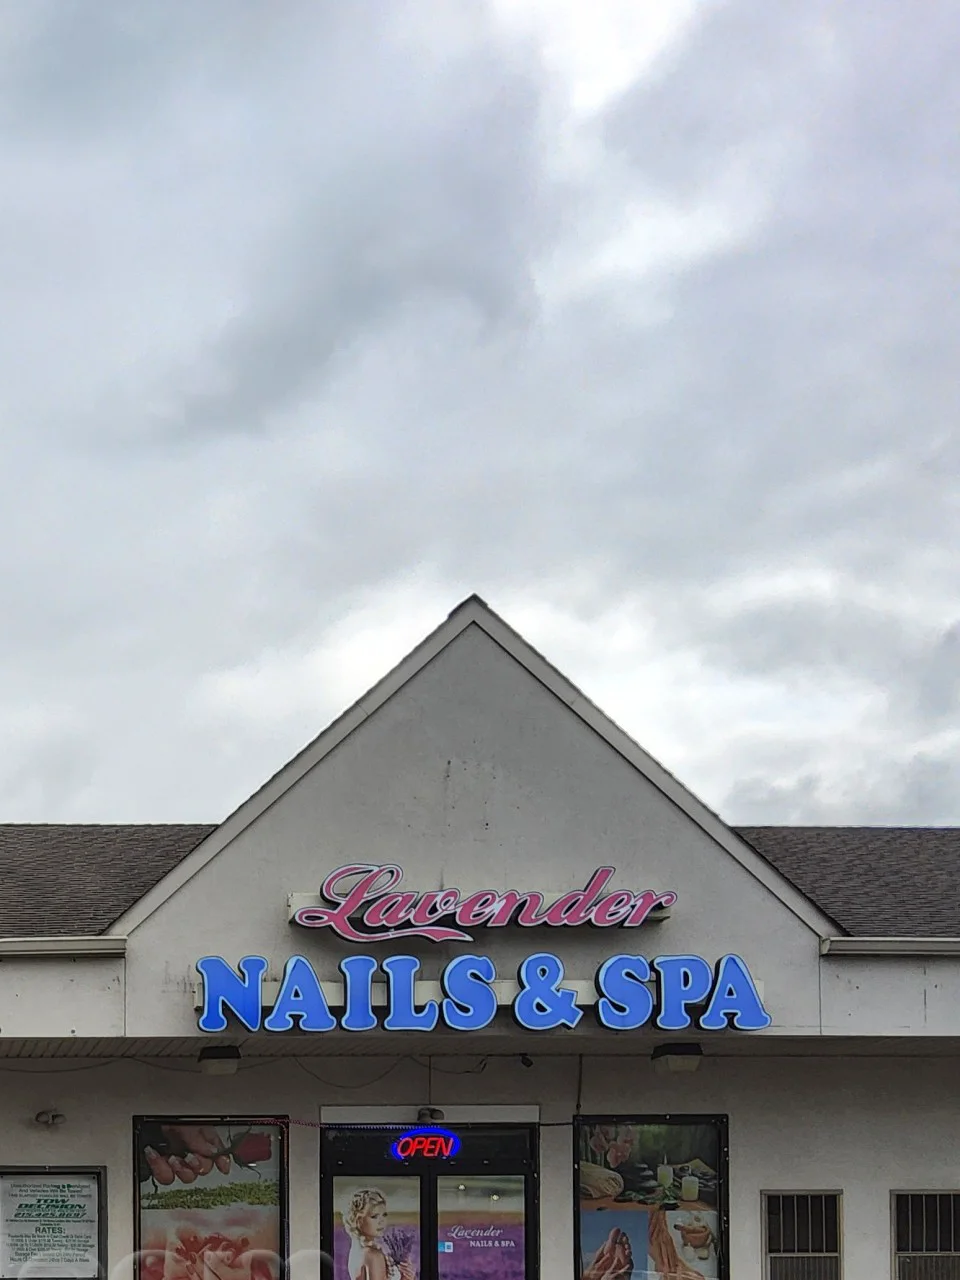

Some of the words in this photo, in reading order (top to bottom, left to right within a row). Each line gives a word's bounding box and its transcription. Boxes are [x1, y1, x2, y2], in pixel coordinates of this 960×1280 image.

[294, 862, 678, 943] Lavender
[397, 1136, 453, 1157] OPEN
[35, 1226, 66, 1234] RATES:
[447, 1224, 504, 1239] Lavender
[469, 1240, 493, 1248] NAILS
[494, 1240, 500, 1248] &
[501, 1240, 515, 1248] SPA
